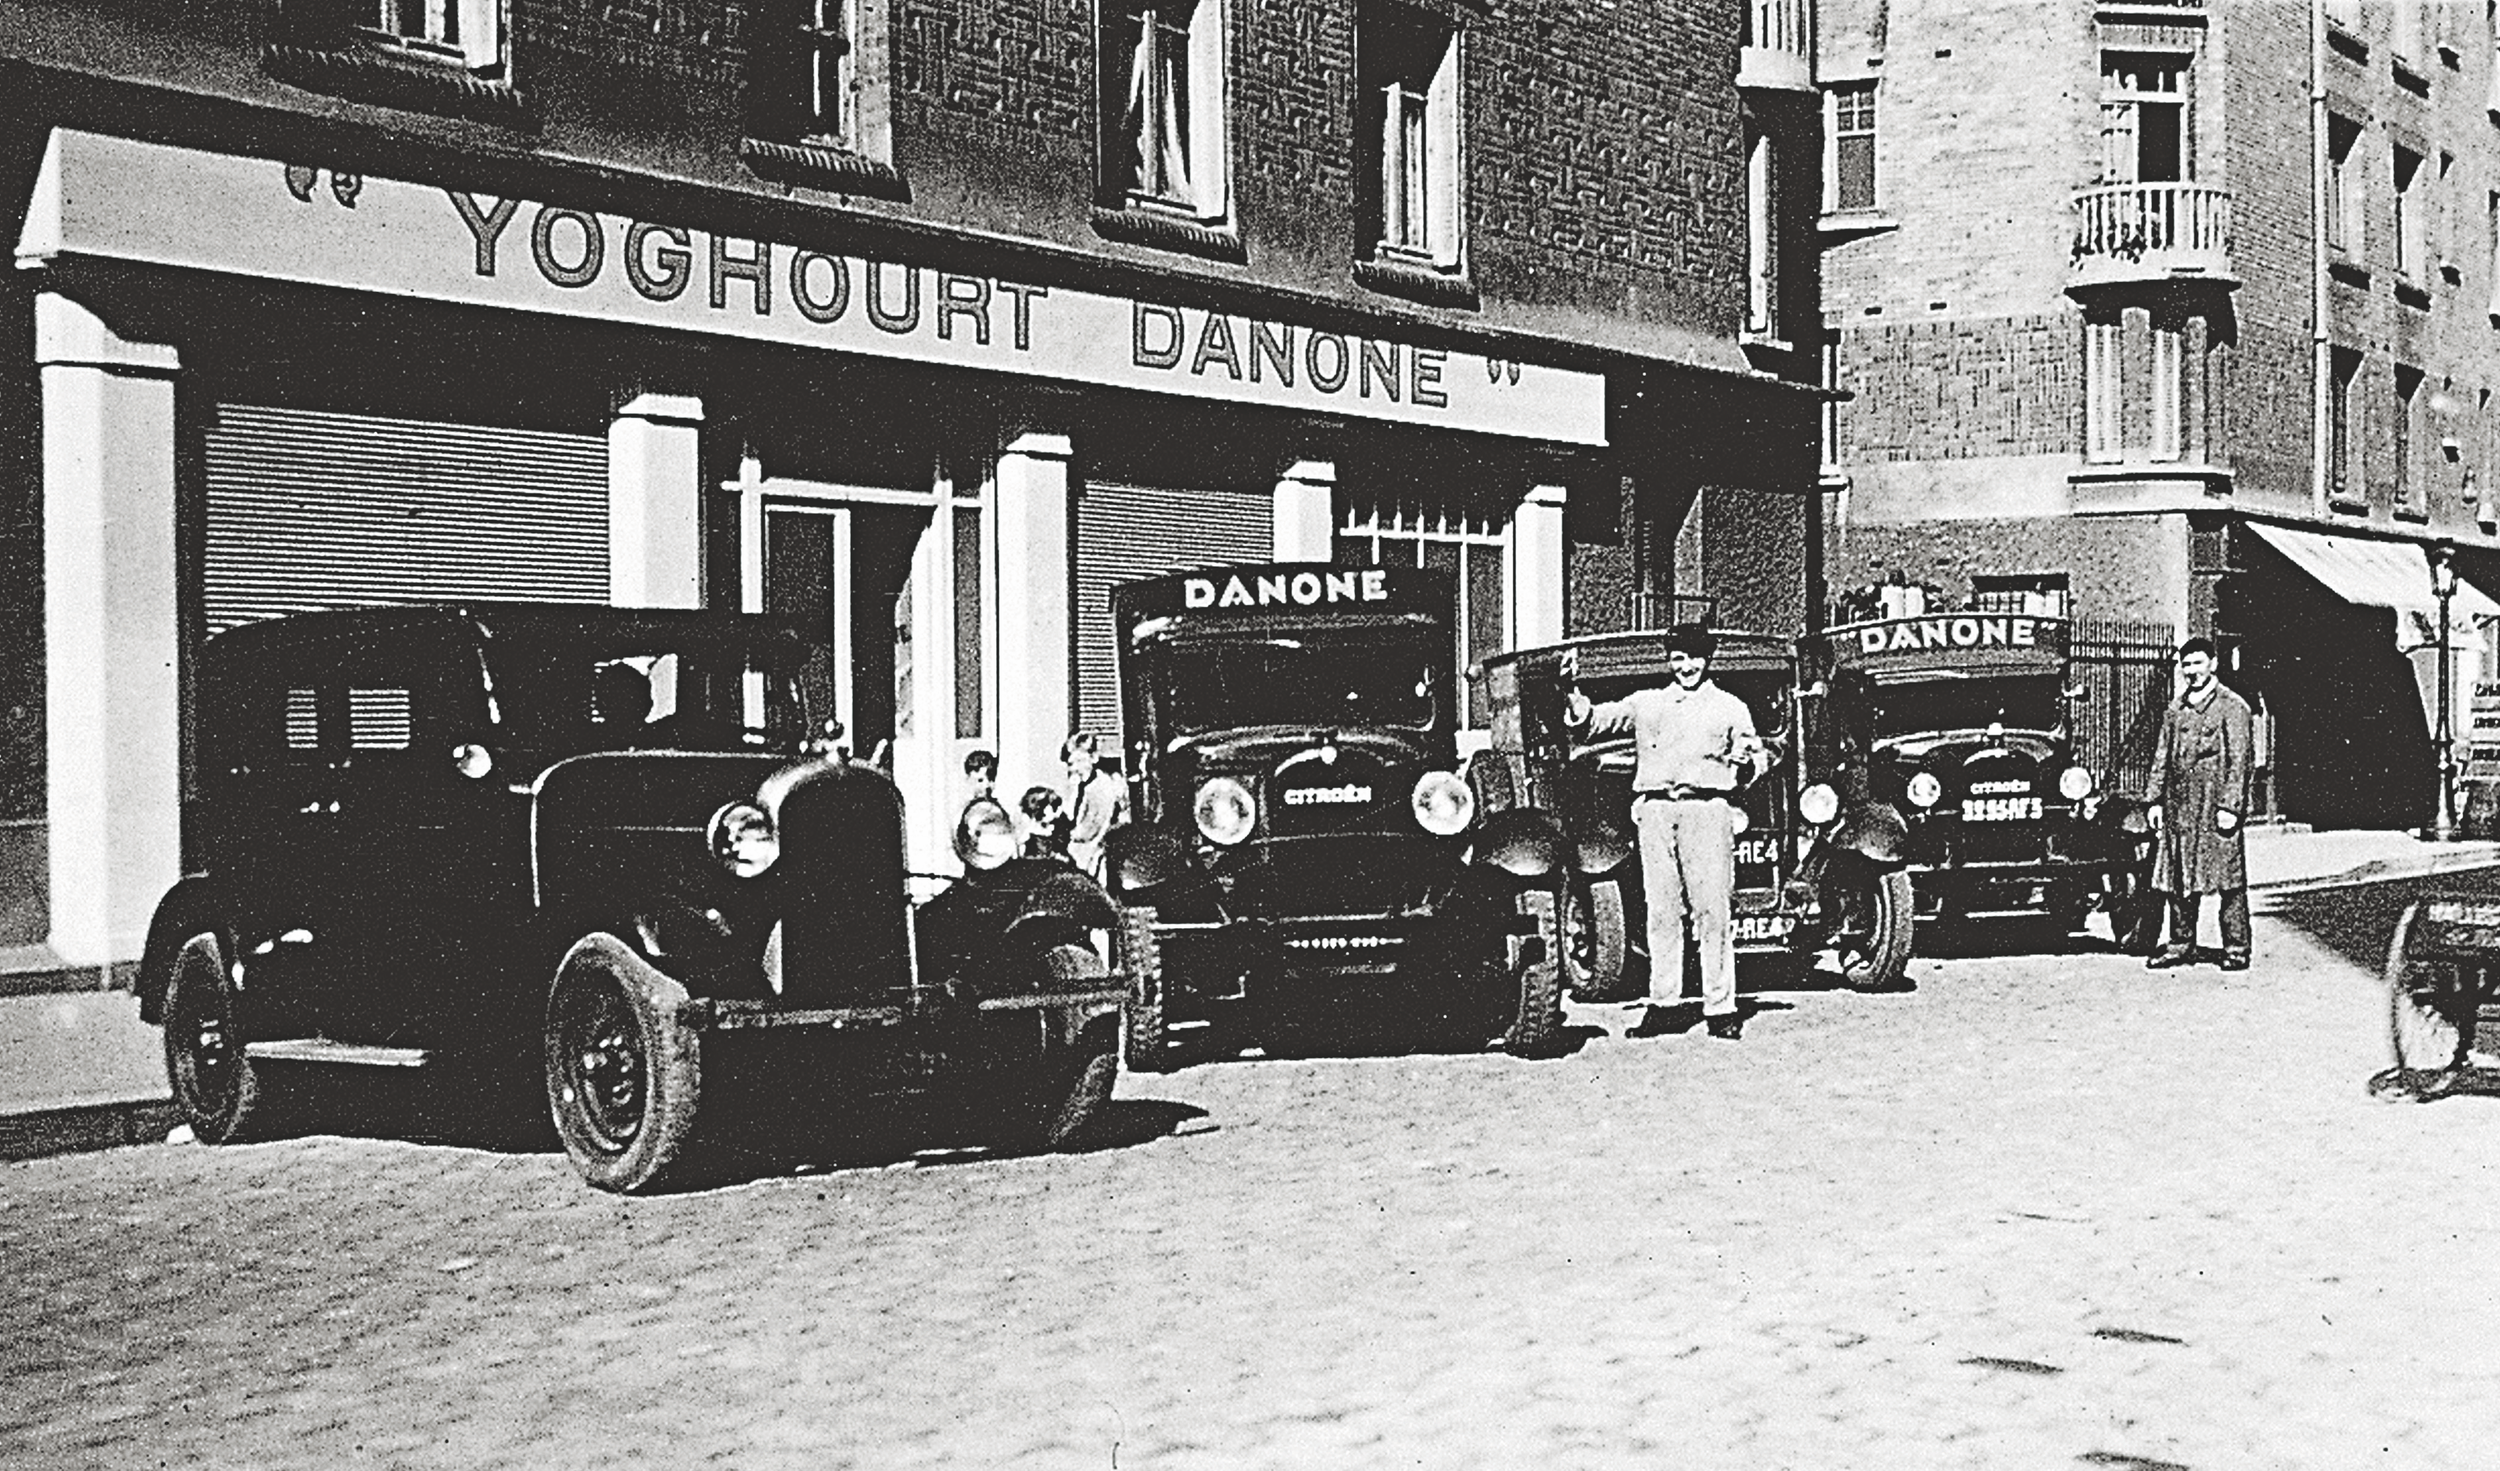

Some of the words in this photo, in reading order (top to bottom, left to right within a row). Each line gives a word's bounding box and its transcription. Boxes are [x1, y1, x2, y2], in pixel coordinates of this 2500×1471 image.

[448, 187, 1049, 350] YOGHOURT
[1131, 299, 1449, 409] DANONE
[1183, 569, 1389, 609] DANONE
